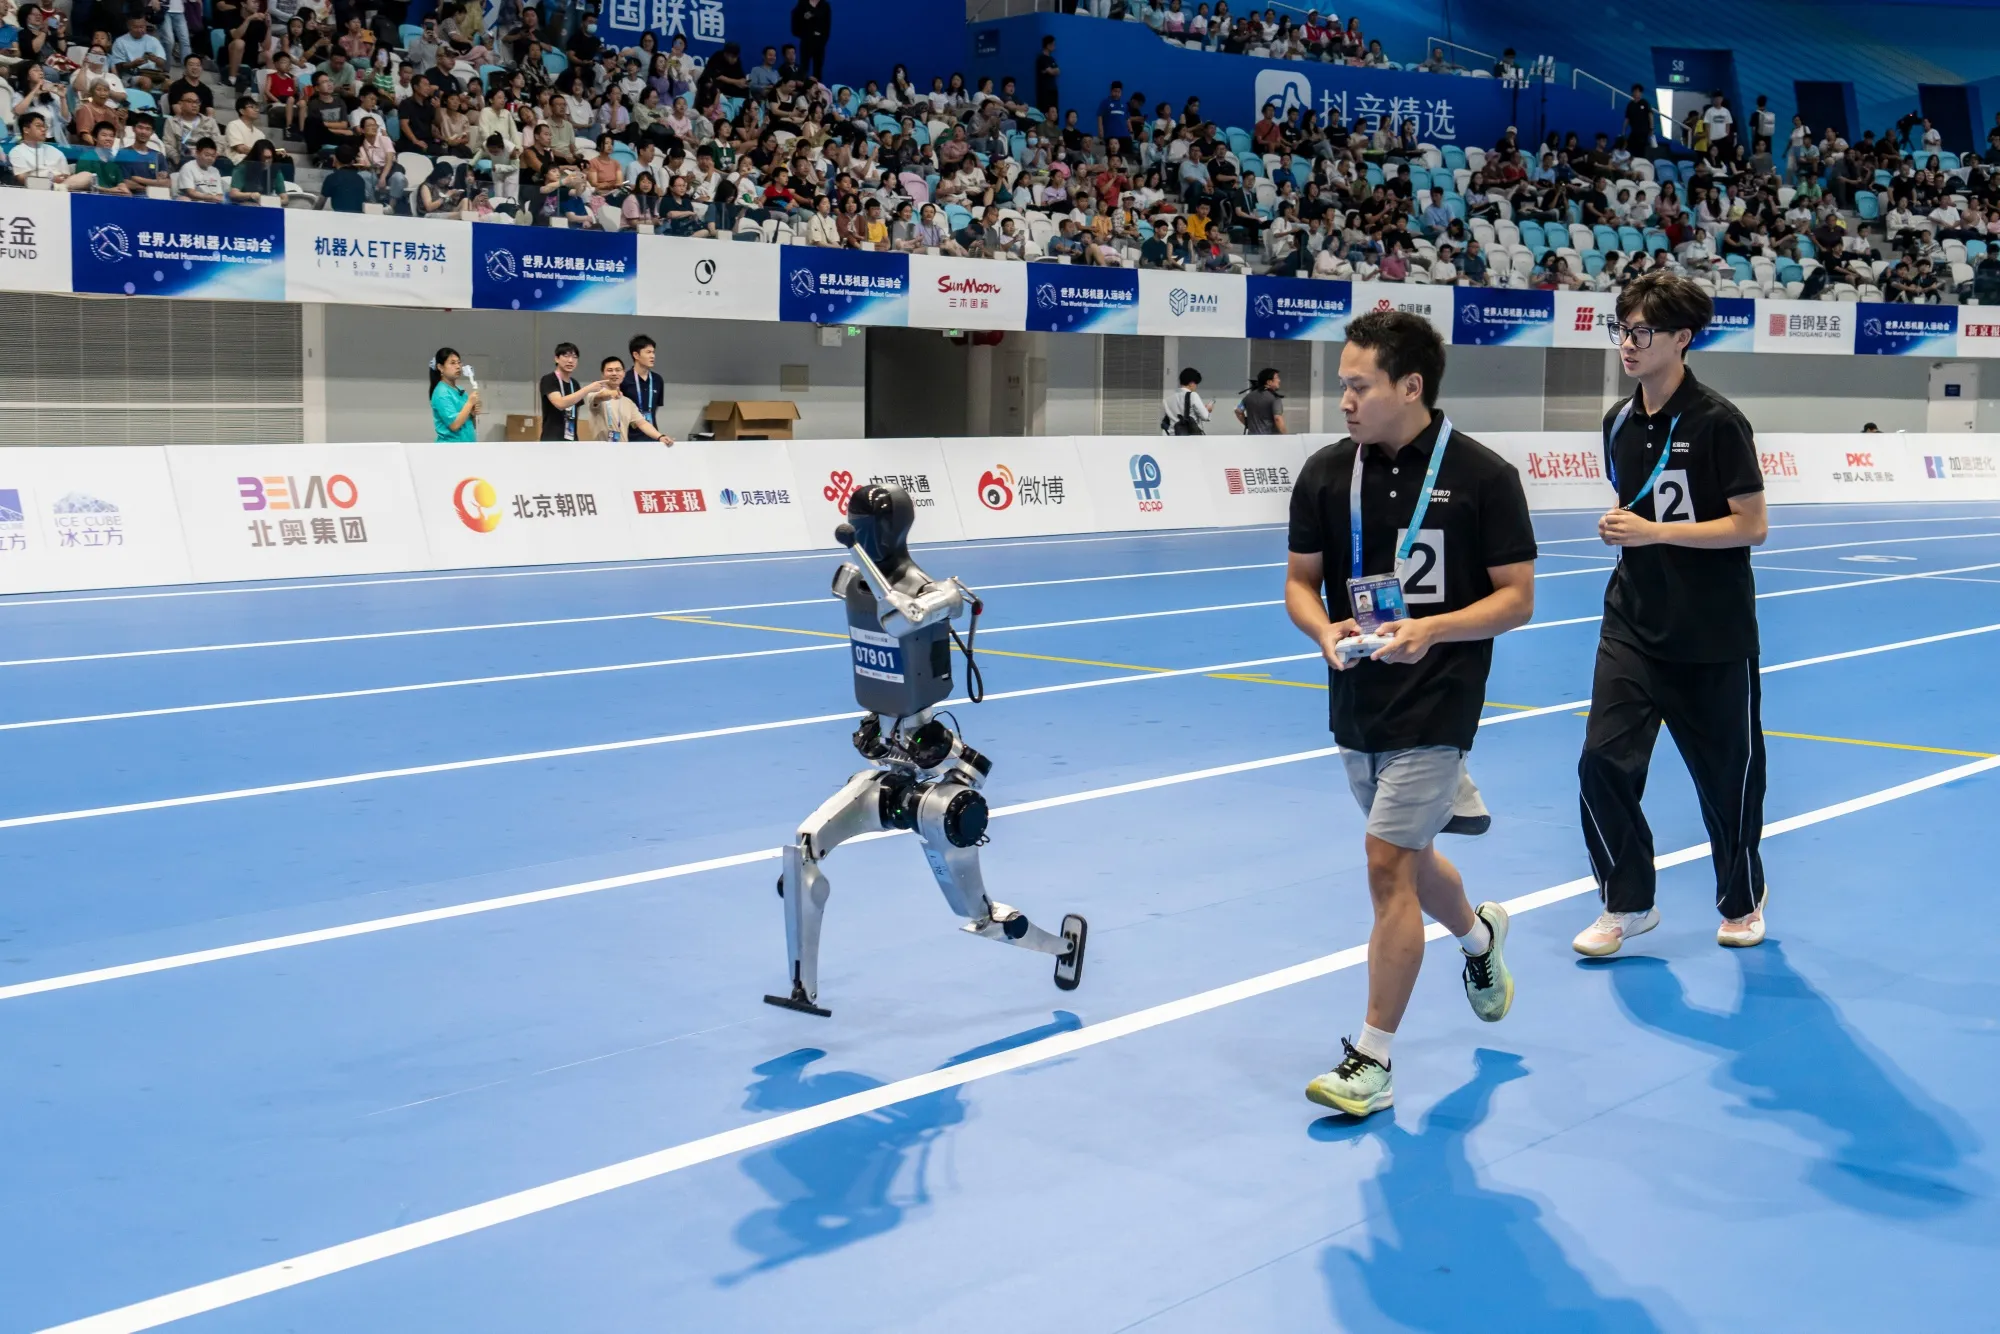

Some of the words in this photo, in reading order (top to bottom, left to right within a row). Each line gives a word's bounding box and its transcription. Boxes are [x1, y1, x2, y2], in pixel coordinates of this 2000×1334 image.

[600, 0, 725, 43] 国联通
[1672, 60, 1684, 72] S8
[1320, 90, 1456, 141] 抖音精选
[0, 217, 36, 246] 金
[138, 232, 272, 253] 世界人形机器人运动会
[315, 237, 446, 262] 机器人ETF易方达
[0, 248, 37, 260] FUND
[138, 250, 153, 259] The
[154, 251, 179, 260] World
[180, 252, 220, 262] Humanoid
[222, 255, 245, 264] Robot
[522, 255, 625, 273] 世界人形机器人运动会
[522, 270, 533, 279] The
[535, 272, 553, 280] World
[819, 273, 901, 289] 世界人形机器人运动会
[938, 275, 1001, 293] SunMoon
[1061, 287, 1132, 301] 世界人形机器人运动会
[1277, 298, 1344, 311] 世界人形机器人运动会
[1789, 314, 1841, 331] 首钢基金
[1527, 451, 1600, 479] 北京经信
[1846, 453, 1873, 467] PICC
[1243, 467, 1291, 486] 首钢基金
[741, 489, 791, 506] 贝壳财经
[1018, 475, 1065, 506] 微博
[512, 493, 597, 519] 北京朝阳
[641, 491, 701, 513] 新京报
[1659, 481, 1690, 523] 2
[55, 517, 79, 527] ICE
[248, 516, 368, 547] 北奥集团
[58, 527, 123, 547] 冰立方
[1403, 542, 1437, 595] 2
[855, 645, 895, 669] 07901
